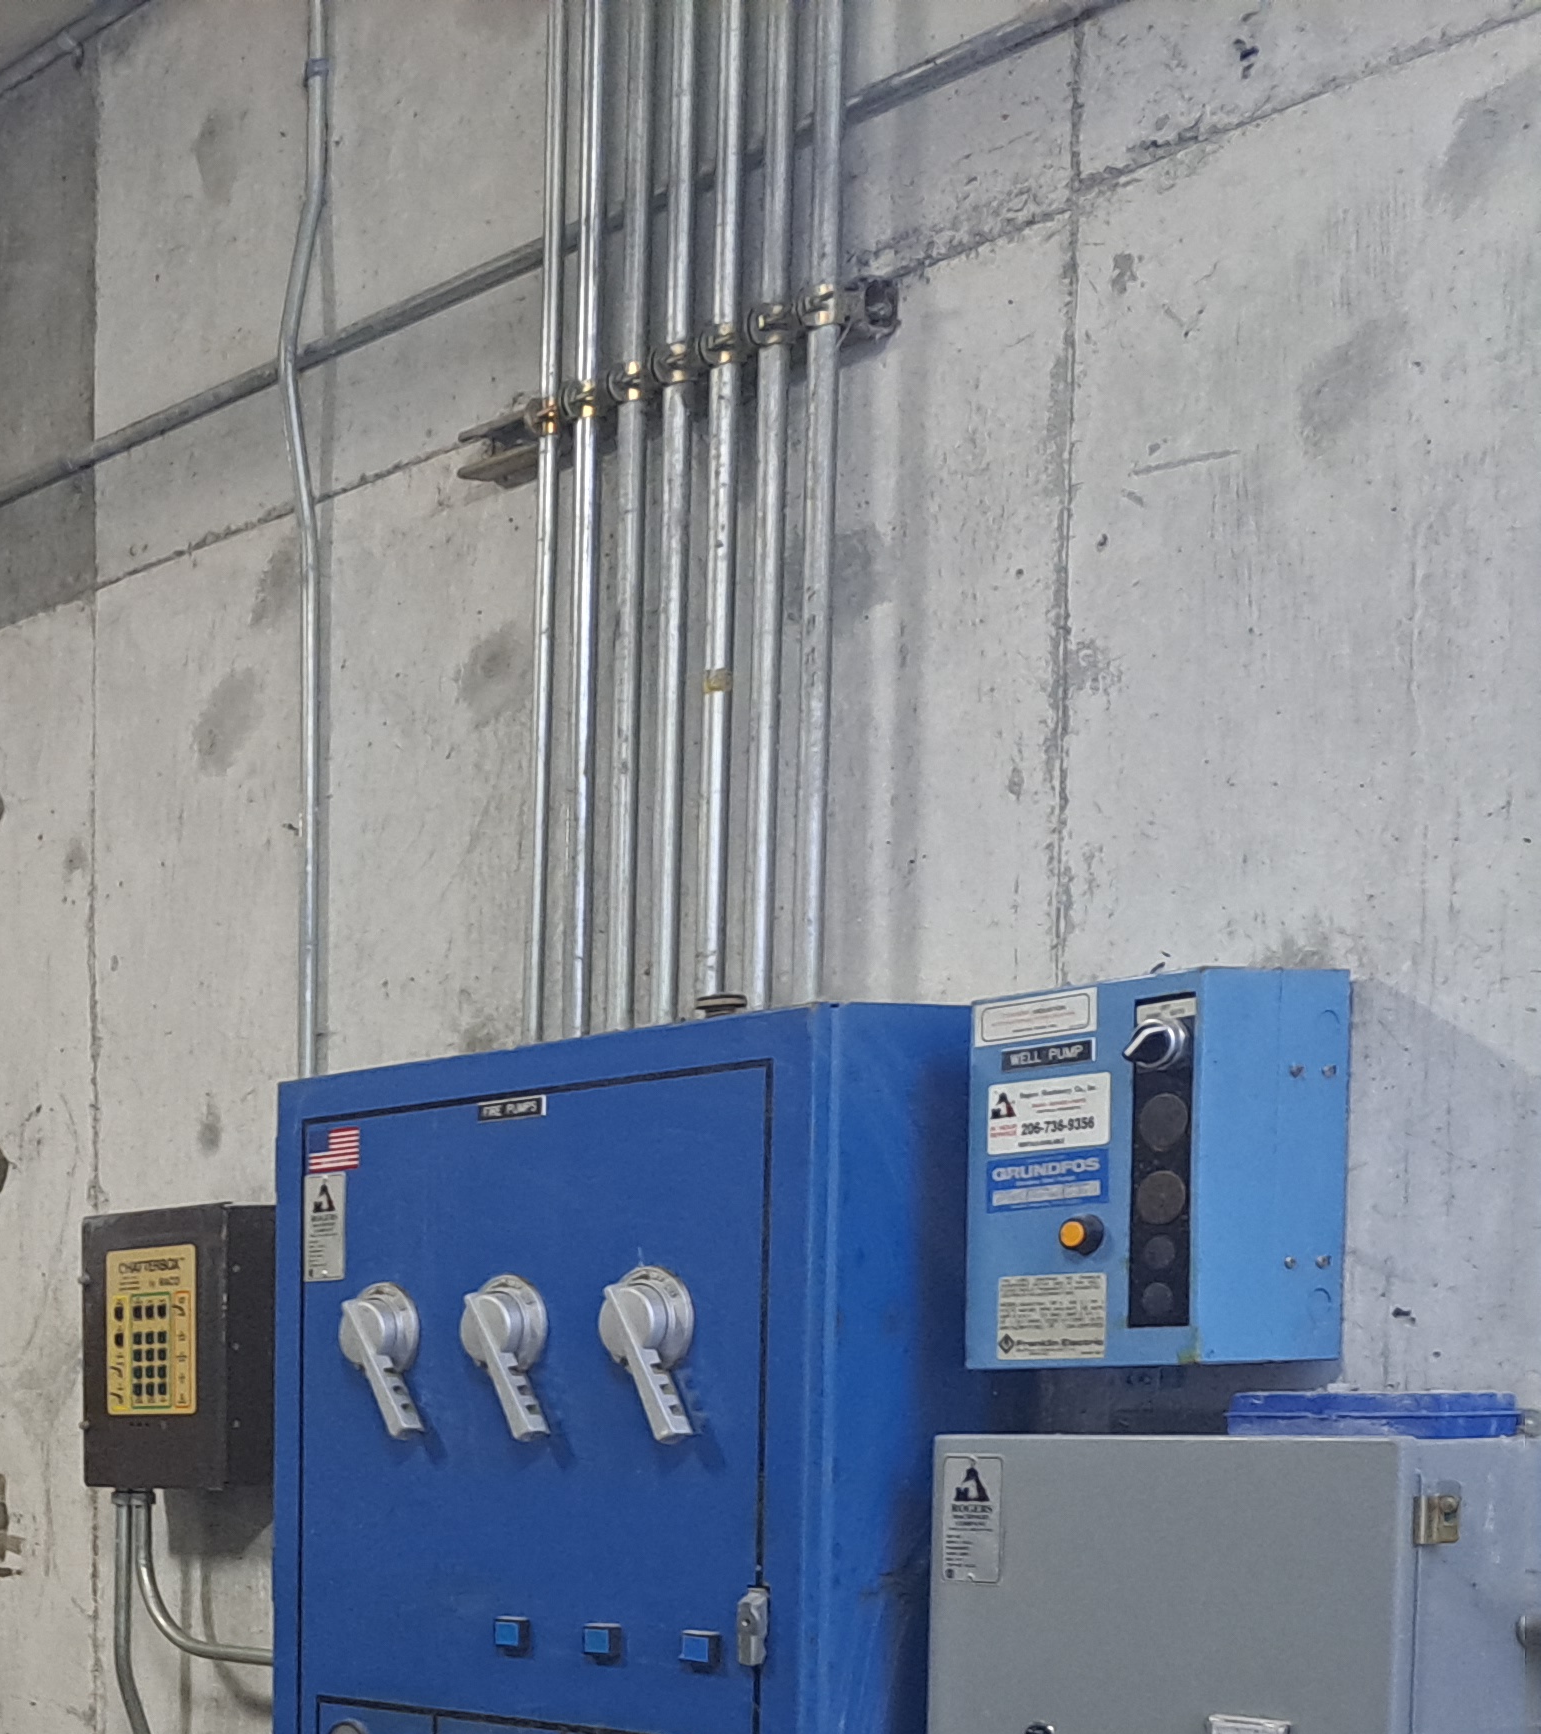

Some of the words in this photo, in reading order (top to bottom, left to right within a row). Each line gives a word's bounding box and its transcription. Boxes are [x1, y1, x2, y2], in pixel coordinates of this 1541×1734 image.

[1010, 1051, 1041, 1066] WELL
[1048, 1045, 1084, 1060] PUMP
[482, 1105, 502, 1117] FIRE
[505, 1101, 537, 1114] PUMPS
[992, 1157, 1101, 1181] GRUNDFOS
